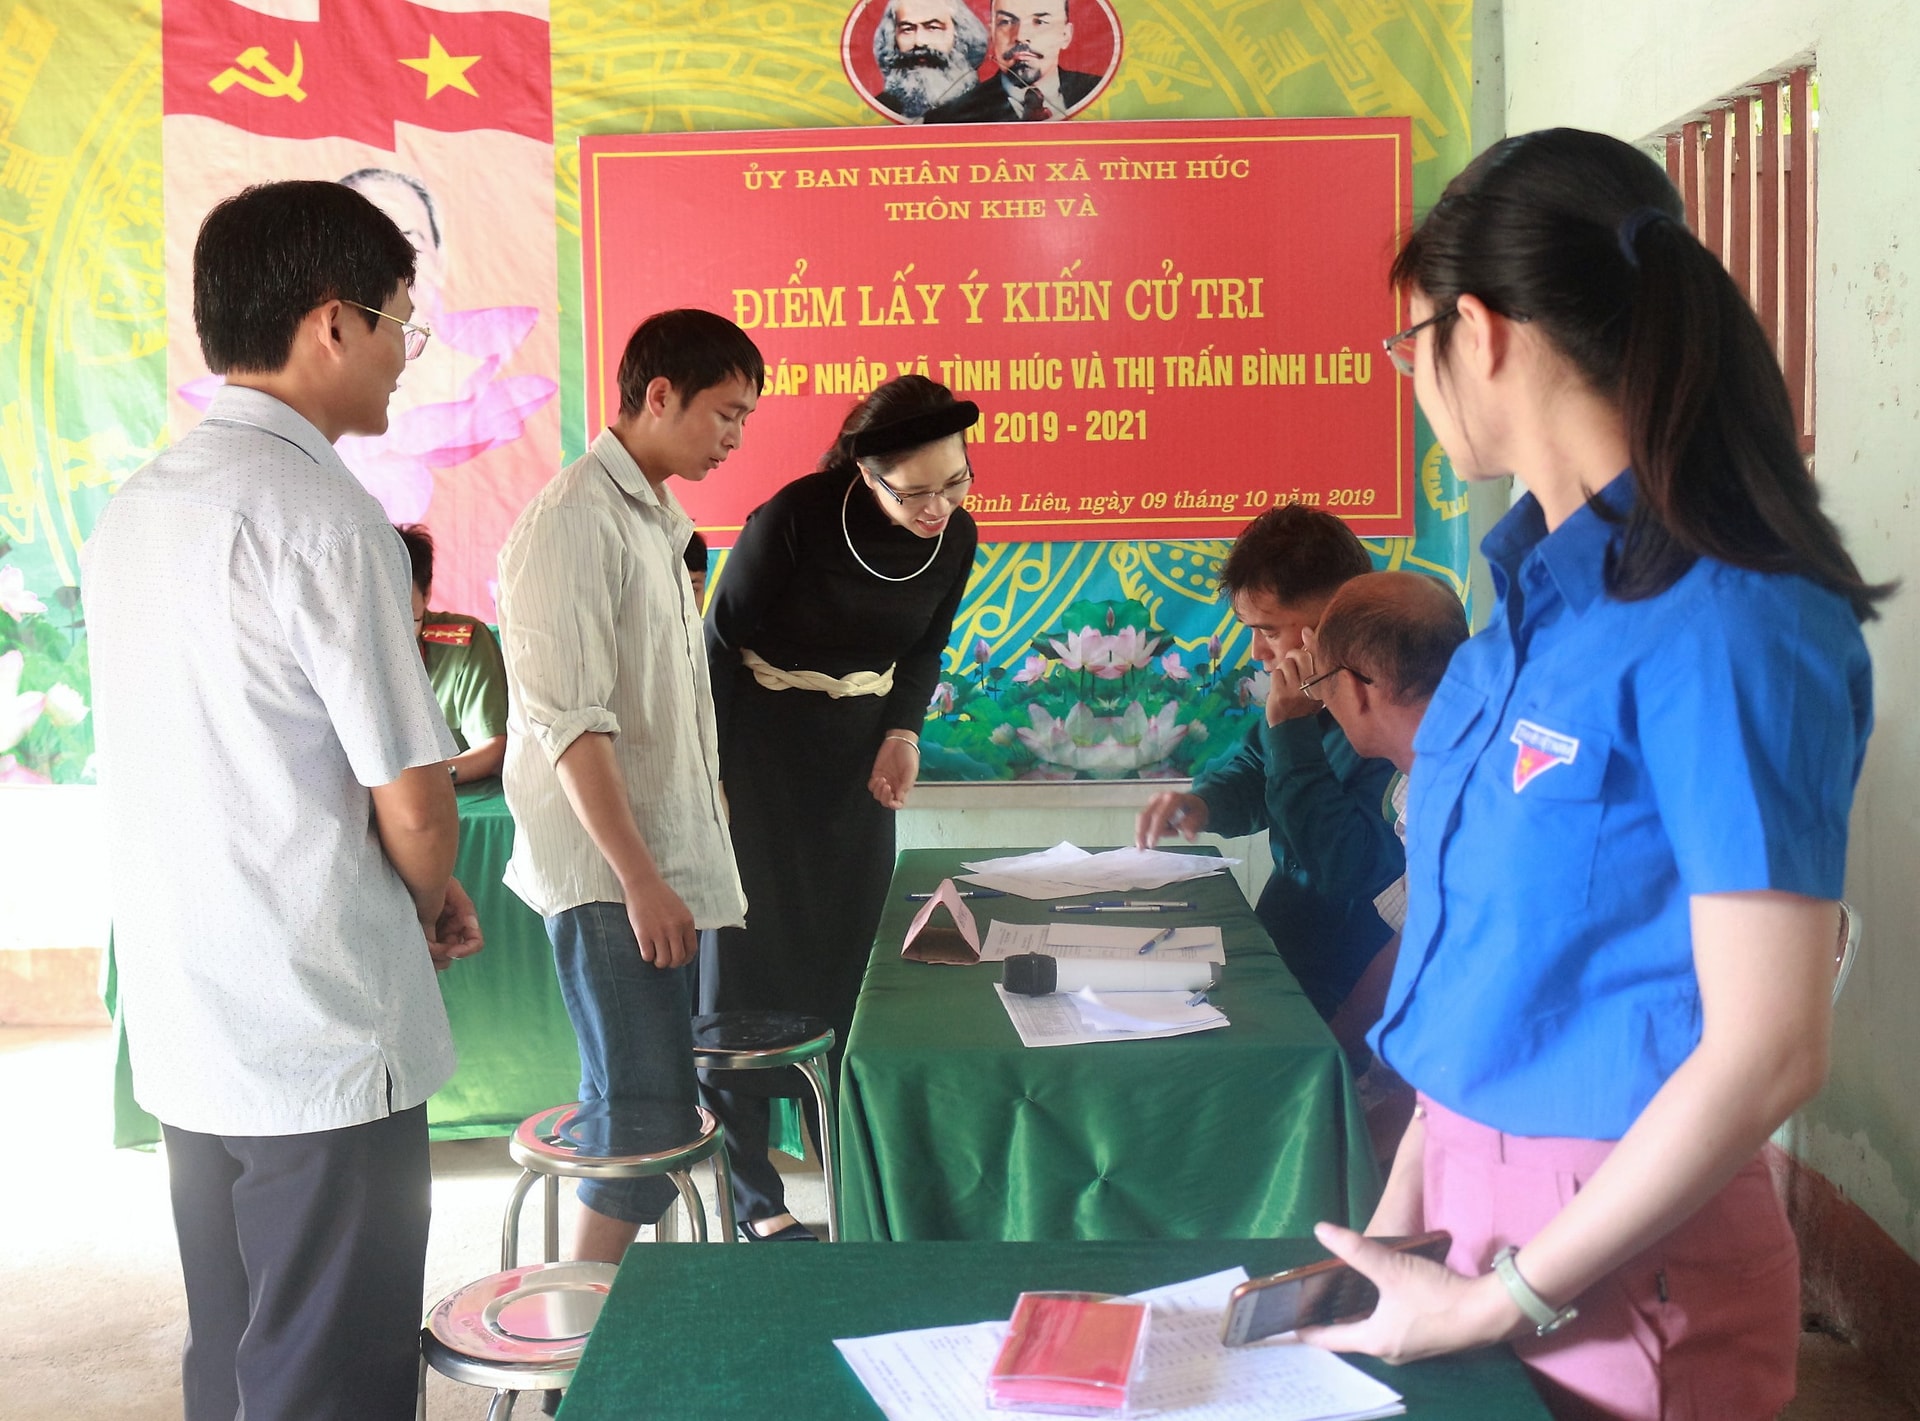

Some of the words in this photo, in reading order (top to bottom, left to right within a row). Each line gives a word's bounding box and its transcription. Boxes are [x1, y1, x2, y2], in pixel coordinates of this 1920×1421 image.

[743, 162, 786, 190] ỦY
[796, 168, 860, 188] BAN
[869, 160, 960, 186] NHÂN
[969, 157, 1036, 184] DÂN
[1045, 158, 1091, 182] XÃ
[1099, 156, 1177, 181] TÌNH
[1186, 154, 1250, 180] HÚC
[885, 195, 972, 221] THÔN
[981, 199, 1046, 219] KHE
[1055, 193, 1099, 217] VÀ
[732, 258, 847, 329] ĐIỂM
[858, 263, 946, 326] LẤY
[958, 268, 989, 324] Ý
[1002, 259, 1112, 322] KIẾN
[1125, 259, 1184, 321] CỬ
[1191, 278, 1264, 319] TRI
[761, 357, 808, 396] SÁP
[815, 356, 887, 401] NHẬP
[940, 353, 1000, 391] TÌNH
[1010, 352, 1063, 390] HÚC
[1071, 351, 1106, 389] VÀ
[1113, 356, 1155, 395] THỊ
[1163, 344, 1233, 387] TRẤN
[1242, 348, 1306, 385] BÌNH
[1315, 346, 1371, 385] LIÊU
[994, 411, 1058, 443] 2019
[1067, 424, 1077, 432] -
[1086, 409, 1146, 441] 2021
[962, 493, 1012, 513] Bình
[1018, 492, 1071, 514] Liêu,
[1078, 491, 1135, 515] ngày
[1141, 492, 1168, 509] 09
[1173, 489, 1239, 512] tháng
[1243, 490, 1268, 507] 10
[1273, 487, 1321, 506] năm
[1327, 488, 1375, 506] 2019
